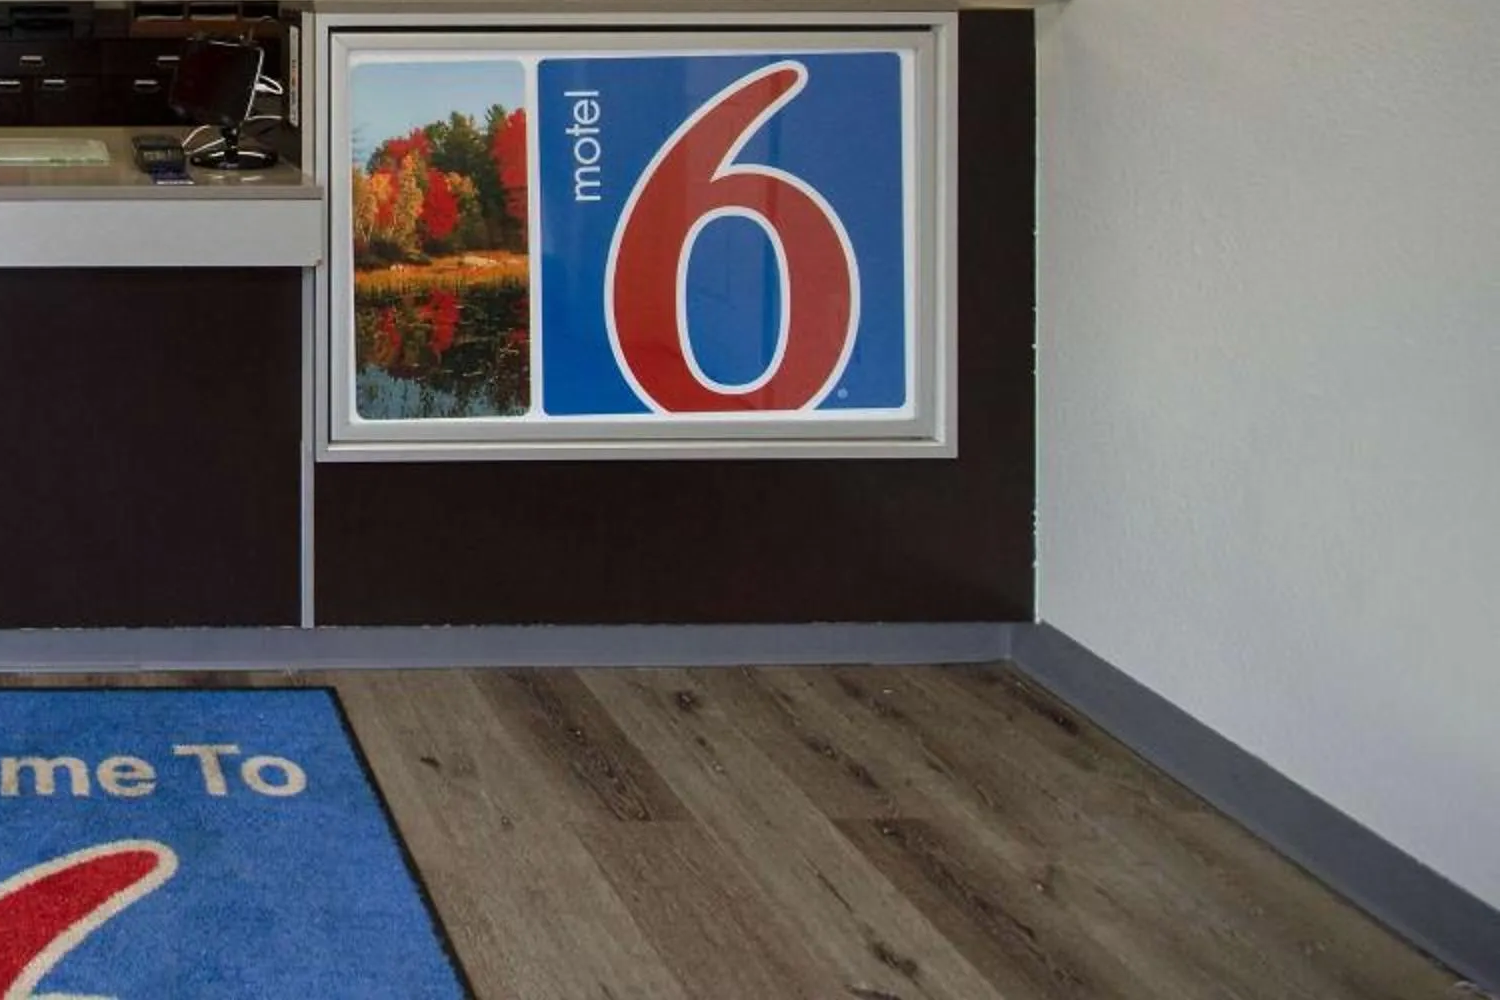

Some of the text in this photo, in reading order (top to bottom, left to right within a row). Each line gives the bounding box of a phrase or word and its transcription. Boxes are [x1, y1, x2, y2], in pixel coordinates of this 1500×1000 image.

[563, 90, 602, 201] motel
[604, 59, 861, 414] 6
[171, 743, 308, 798] To
